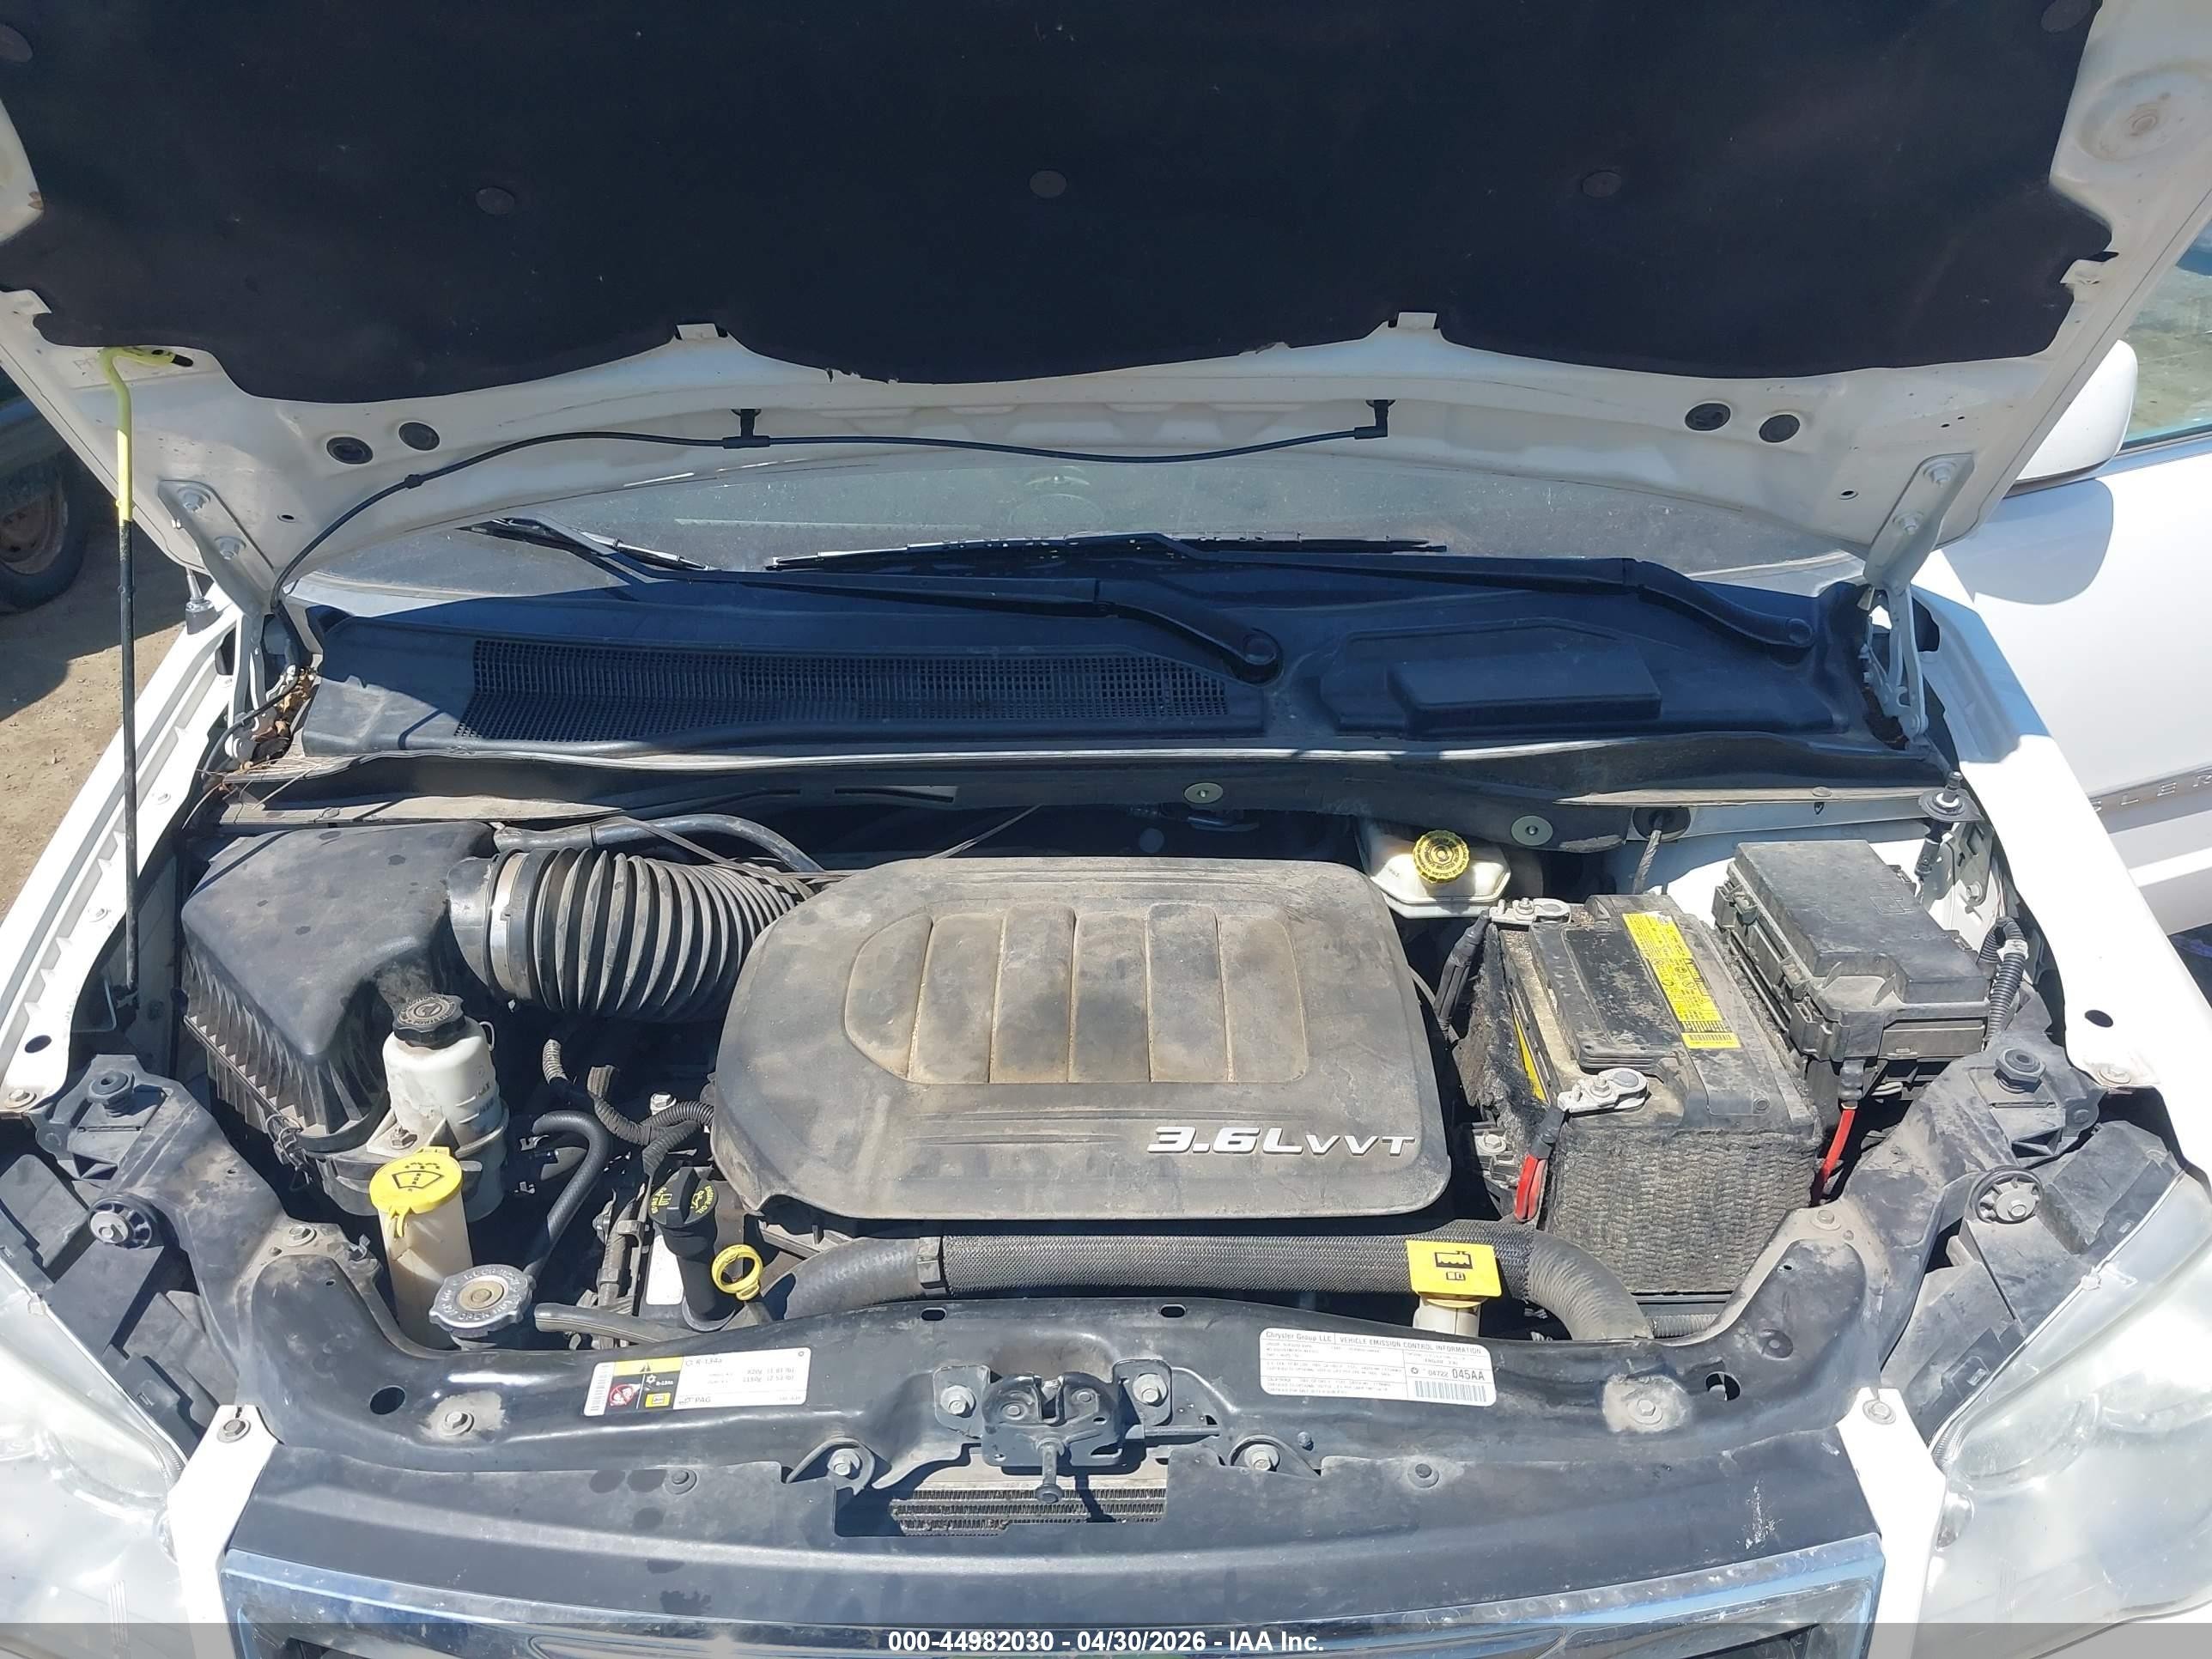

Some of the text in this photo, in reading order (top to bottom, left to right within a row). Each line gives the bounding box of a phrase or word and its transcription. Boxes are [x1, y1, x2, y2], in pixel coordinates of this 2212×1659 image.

[1266, 1331, 1332, 1342] Chrysler Group LLC
[1340, 1336, 1481, 1354] VEHICLE EMISSION CONTROL INFORMATION
